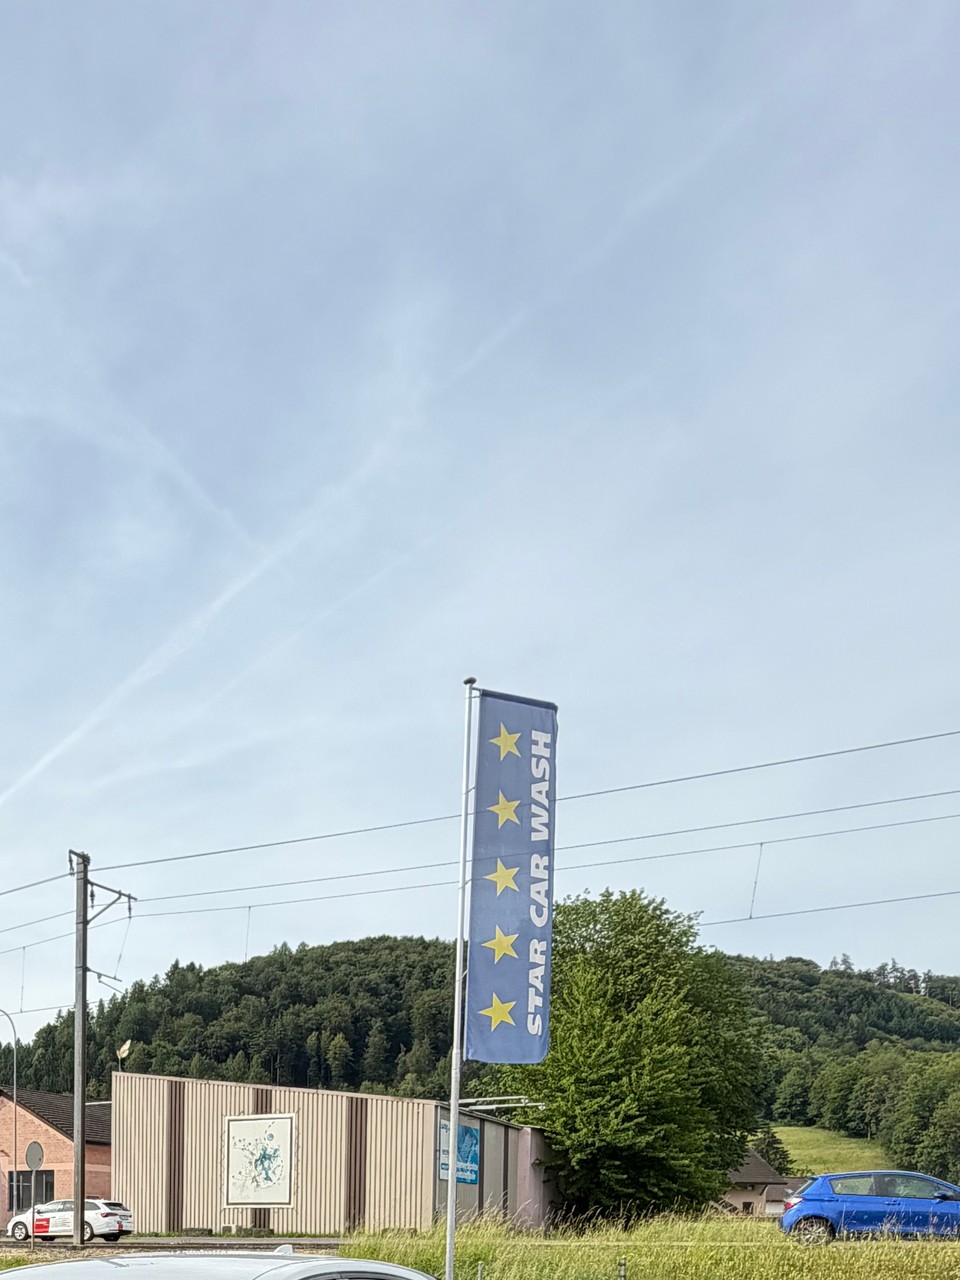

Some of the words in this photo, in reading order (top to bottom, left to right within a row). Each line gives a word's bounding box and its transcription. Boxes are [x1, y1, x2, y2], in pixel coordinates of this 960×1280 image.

[531, 730, 551, 842] WASH
[530, 854, 549, 928] CAR
[528, 939, 547, 1035] STAR
